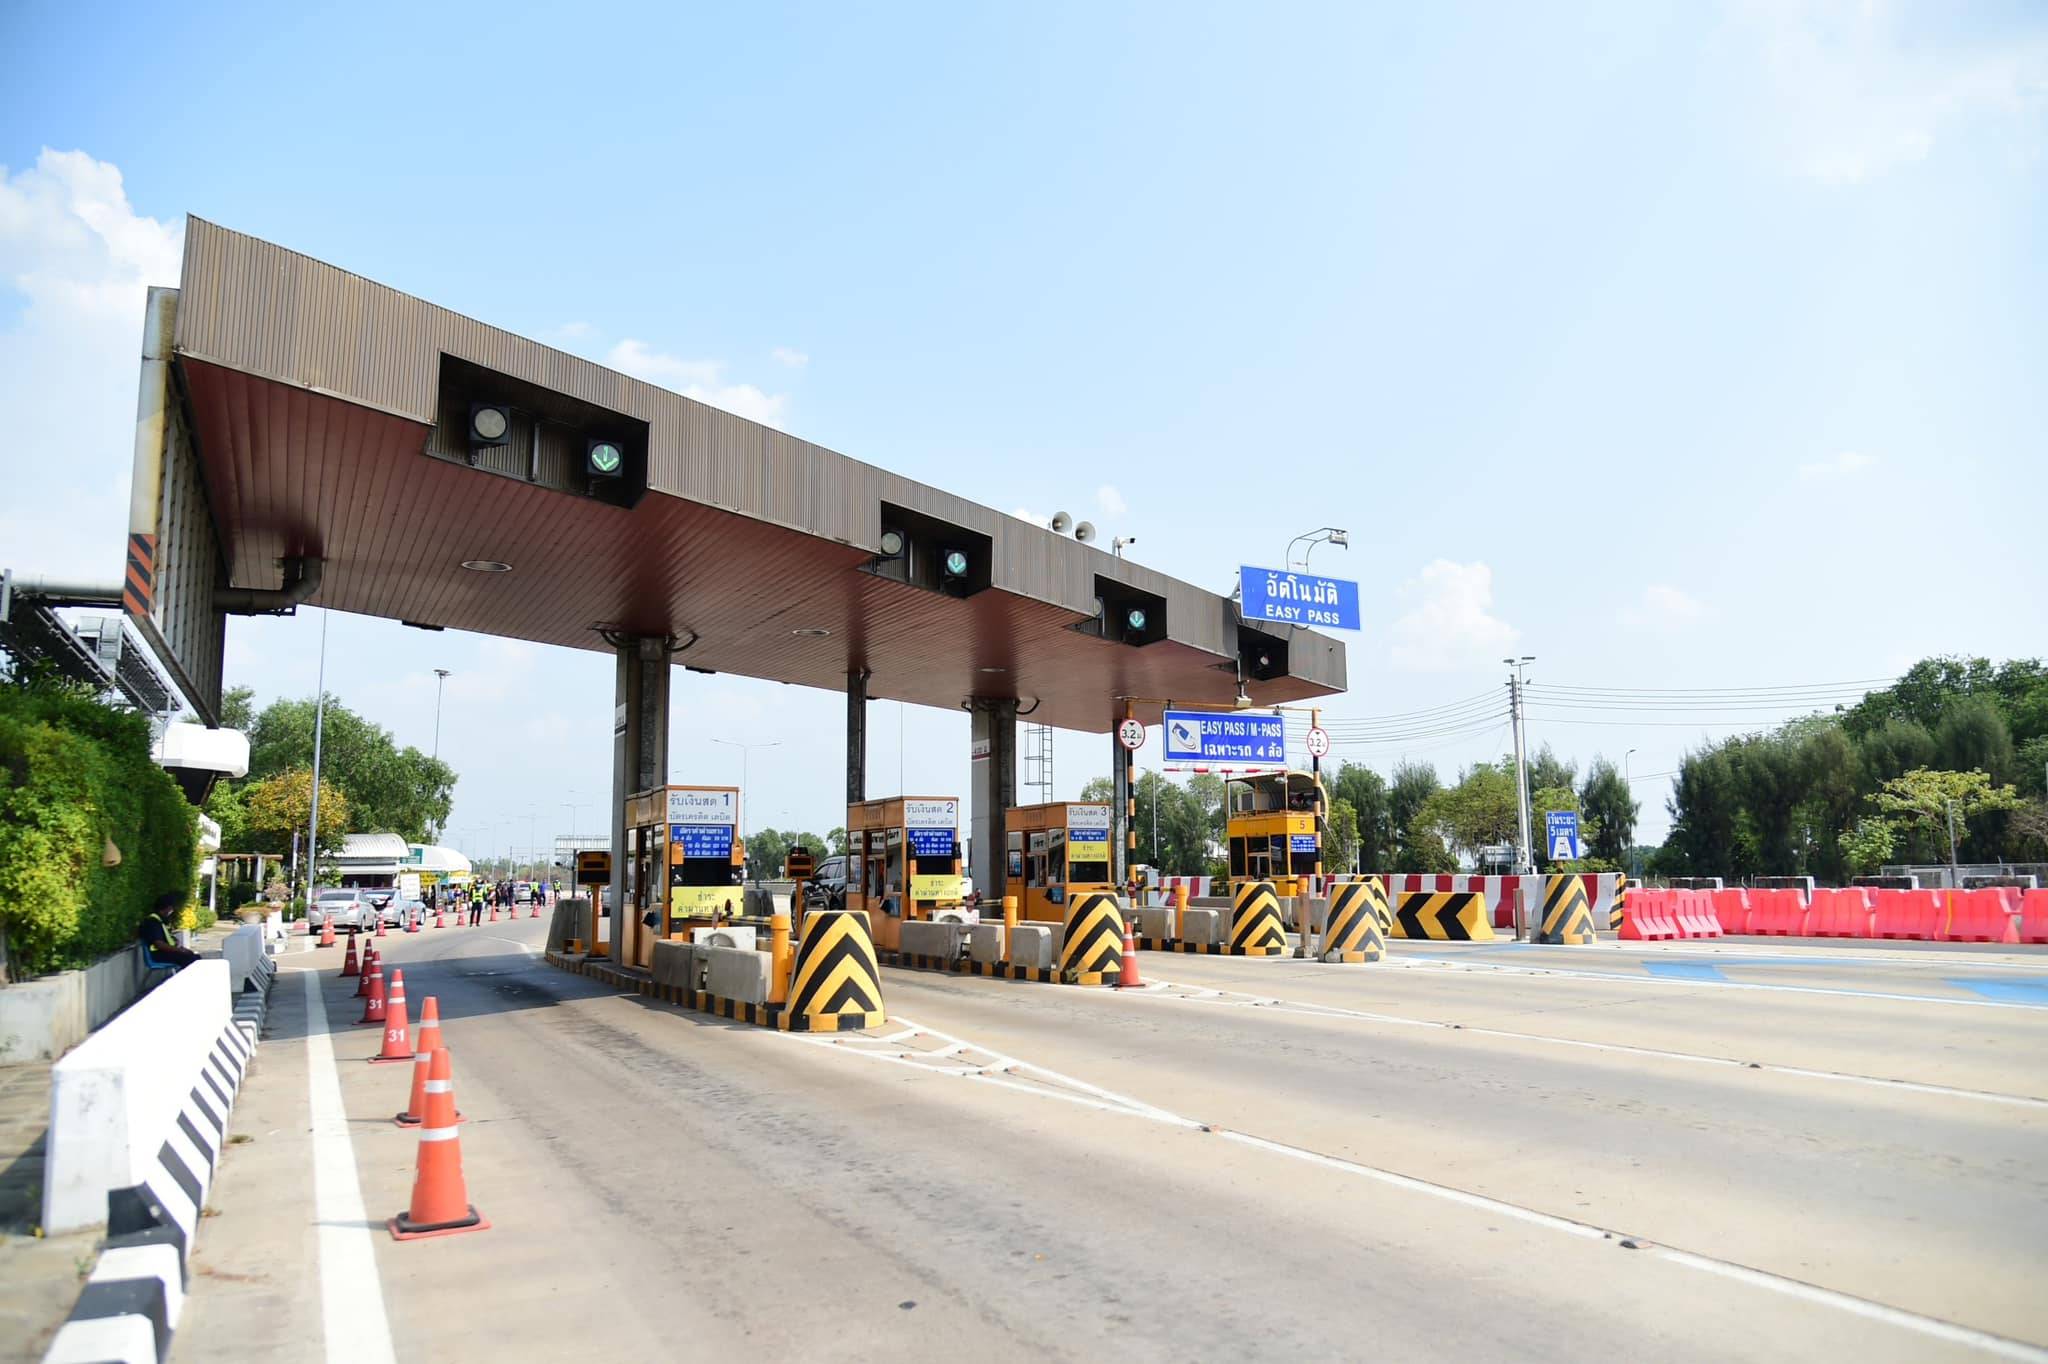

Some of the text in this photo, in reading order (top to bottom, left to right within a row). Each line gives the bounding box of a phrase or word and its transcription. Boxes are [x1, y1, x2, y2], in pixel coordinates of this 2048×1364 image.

[1266, 572, 1338, 605] อัตโนมัติ
[1266, 604, 1340, 624] EASY PASS
[1201, 720, 1222, 735] EASY
[1224, 721, 1245, 736] PASS
[1204, 741, 1282, 758] เฉพาะรถ 4 ล้อ
[723, 793, 729, 806] 1
[946, 802, 954, 813] 2
[1101, 807, 1107, 816] 3
[1300, 820, 1305, 829] 5
[1550, 826, 1555, 836] 5
[369, 999, 382, 1009] 31
[388, 1029, 405, 1042] 31
